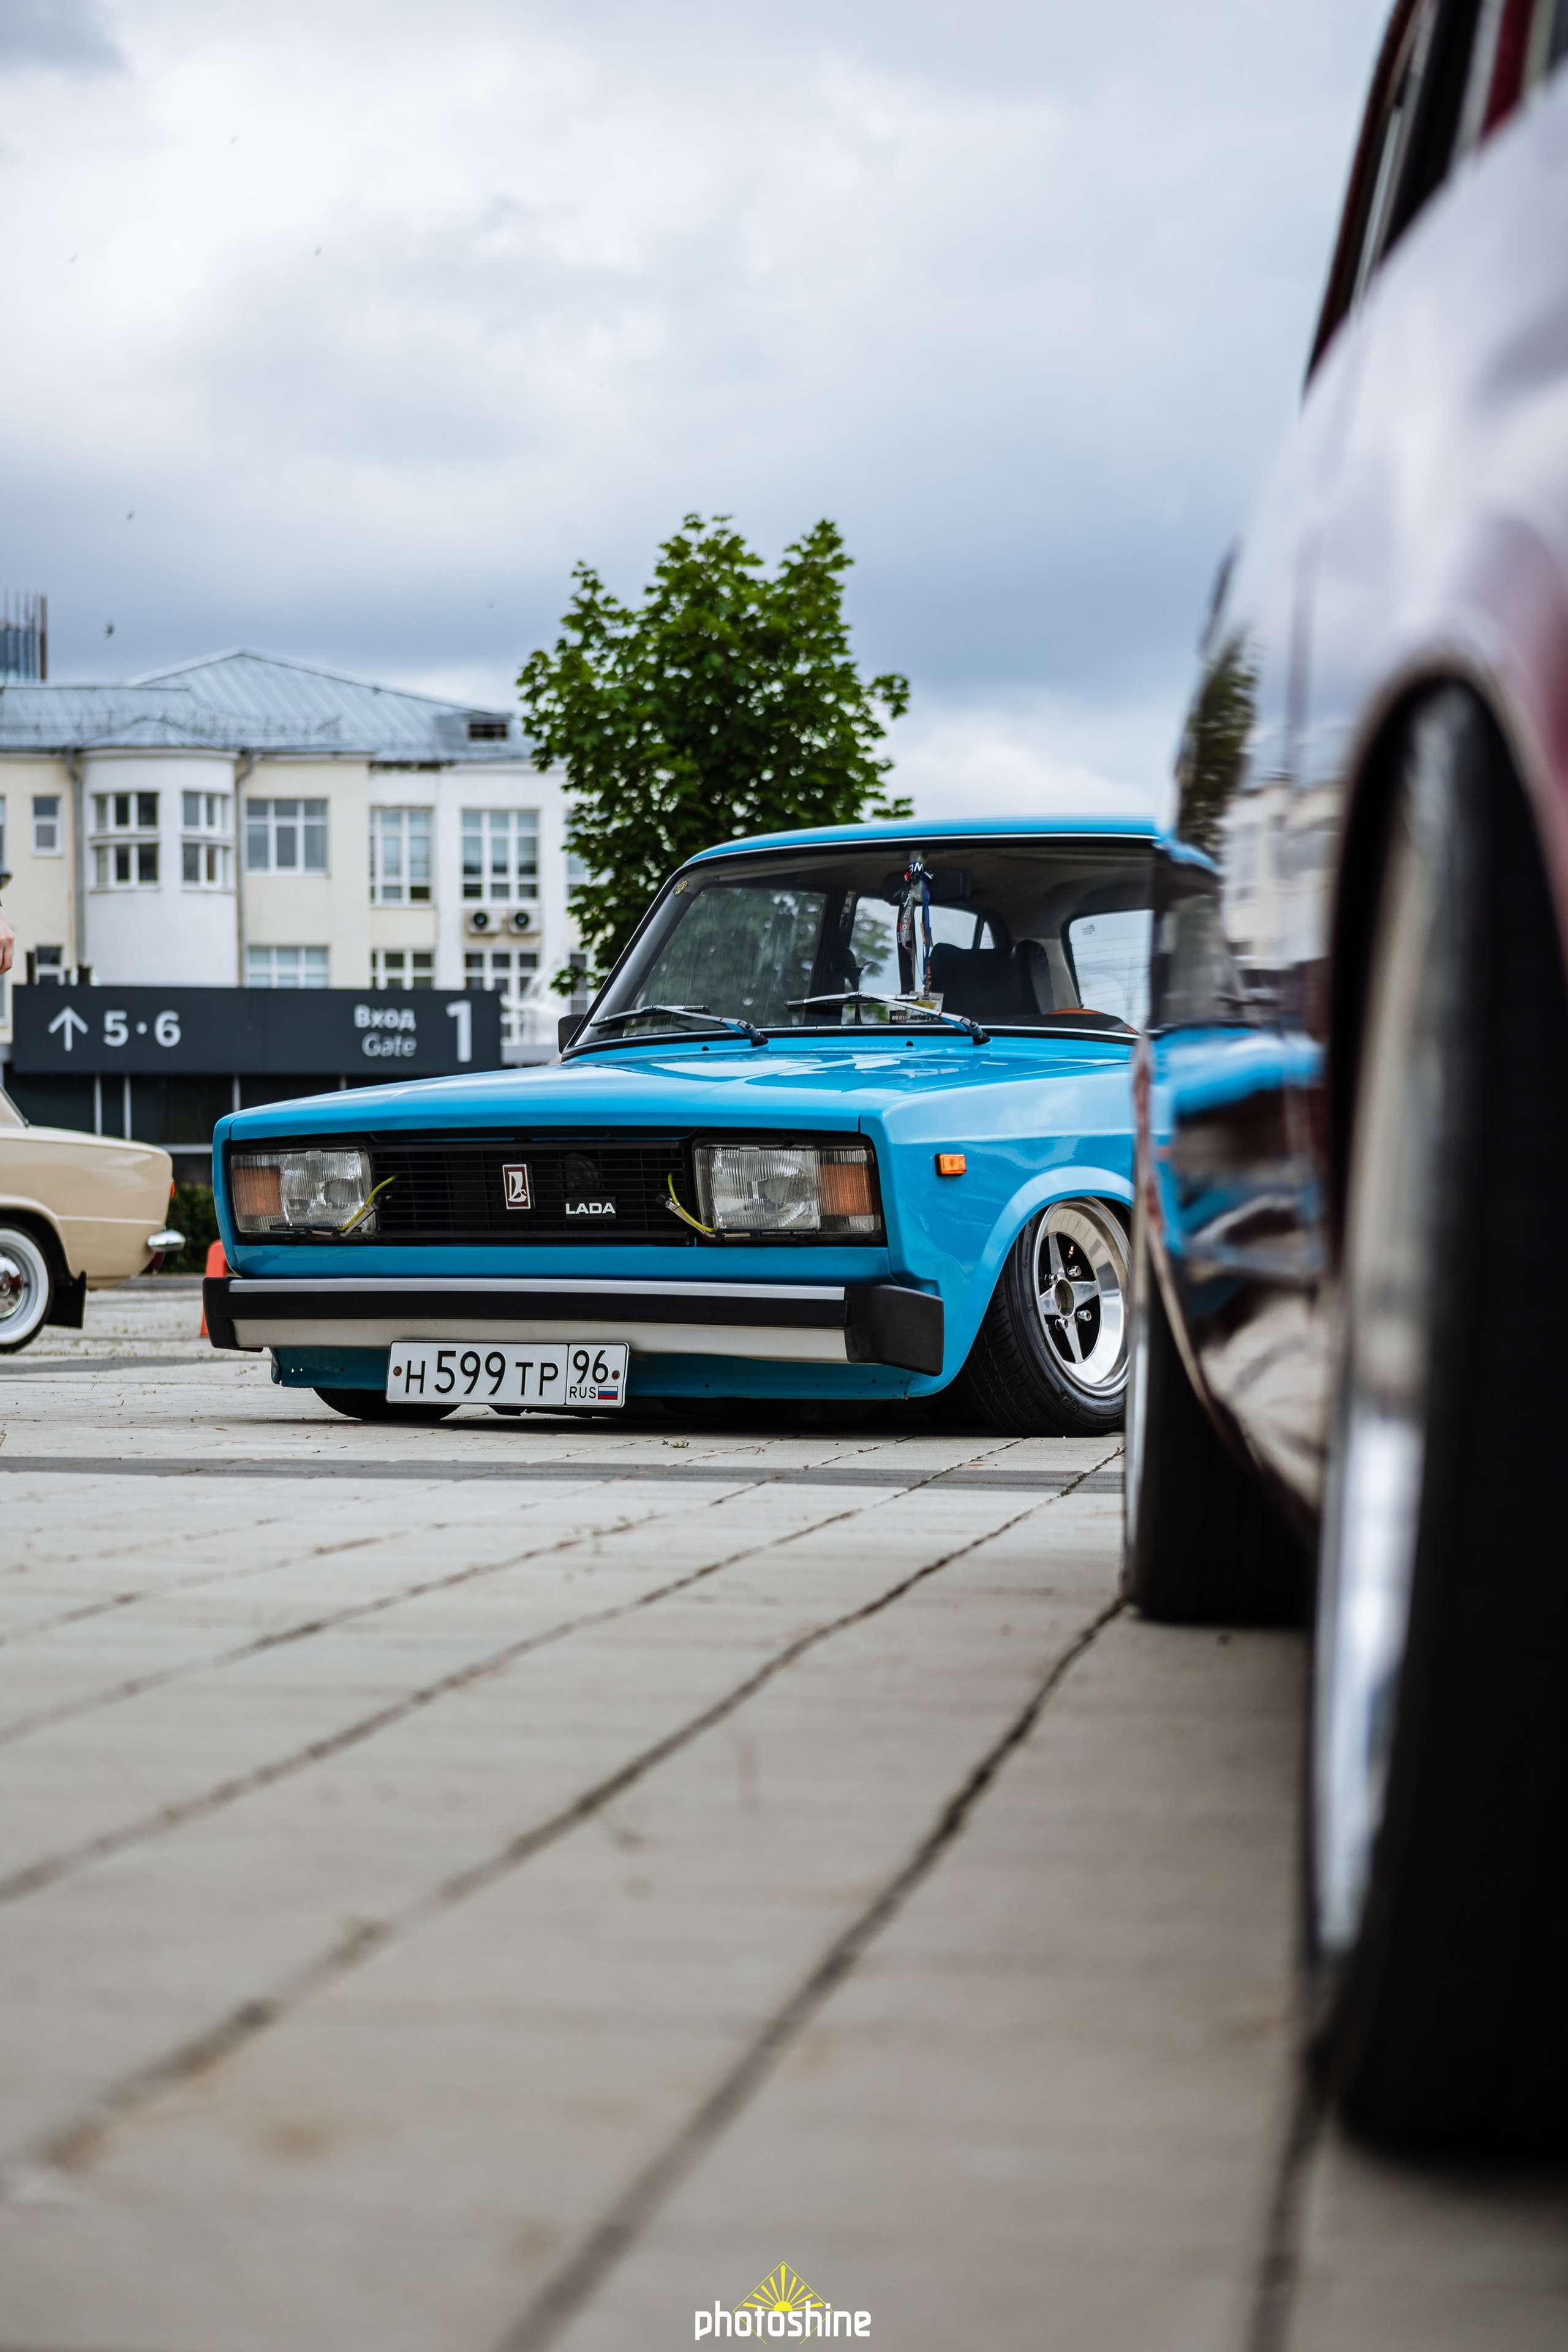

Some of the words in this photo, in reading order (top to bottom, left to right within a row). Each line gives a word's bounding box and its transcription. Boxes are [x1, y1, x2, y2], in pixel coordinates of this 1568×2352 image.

[354, 1005, 417, 1031] Вход
[446, 1000, 472, 1062] 1
[362, 1034, 417, 1057] Gate
[565, 1202, 616, 1215] LADA
[573, 1350, 609, 1384] 96
[569, 1386, 597, 1399] RUS
